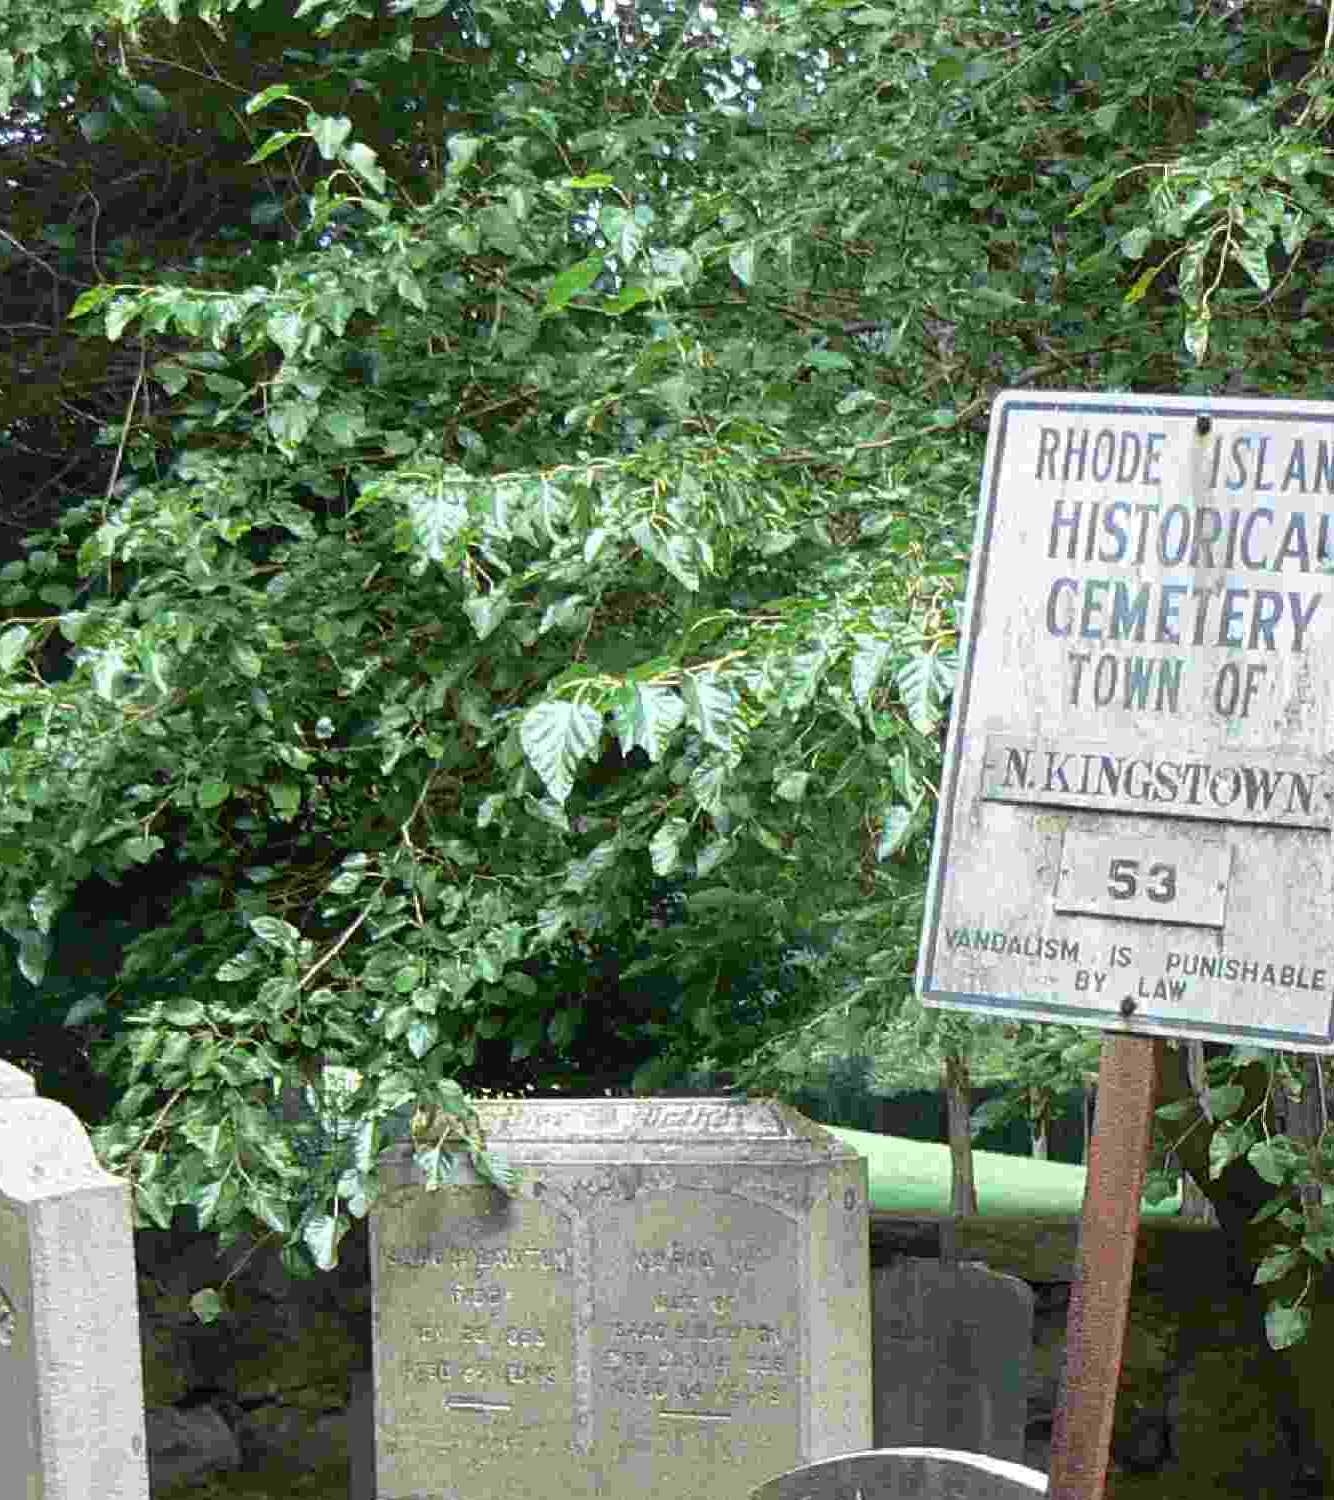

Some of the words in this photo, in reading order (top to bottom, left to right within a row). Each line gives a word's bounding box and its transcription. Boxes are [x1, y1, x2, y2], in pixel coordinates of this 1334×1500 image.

[1034, 427, 1166, 483] RHODE
[1046, 577, 1323, 653] CEMETERY
[1067, 653, 1188, 714] TOWN
[1215, 662, 1268, 719] OF
[1106, 859, 1177, 903] 53
[945, 929, 1080, 962] VANDALISM
[1109, 946, 1133, 968] IS
[1166, 952, 1327, 991] PUNISHABLE
[1074, 970, 1107, 993] BY
[1138, 978, 1187, 1002] LAW
